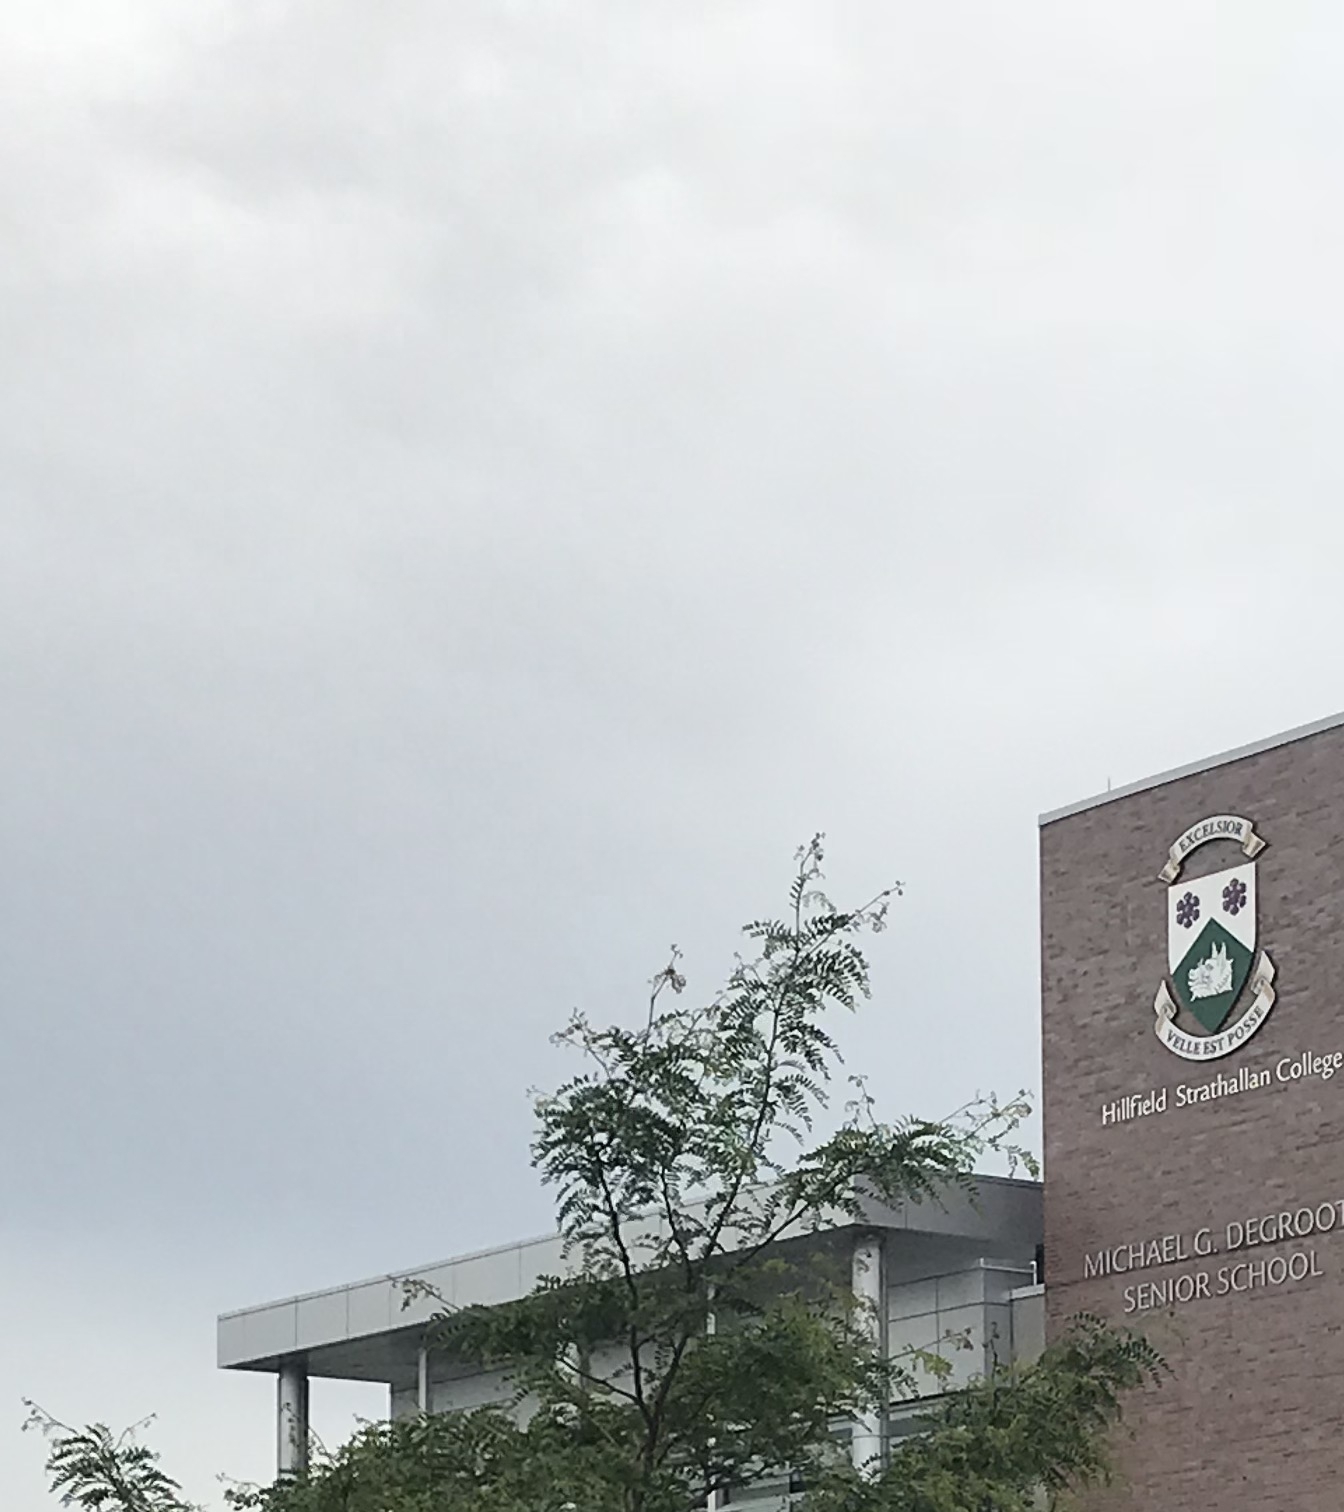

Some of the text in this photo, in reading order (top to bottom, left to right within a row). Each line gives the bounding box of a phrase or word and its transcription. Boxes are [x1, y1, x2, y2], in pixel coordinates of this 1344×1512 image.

[1178, 820, 1244, 853] EXCELSIOR
[1167, 1005, 1264, 1055] VELLE EST POSSE
[1102, 1051, 1343, 1125] Hillfield Strathallan College
[1084, 1234, 1188, 1279] MICHAEL
[1194, 1228, 1218, 1256] G.
[1123, 1250, 1324, 1313] SENIOR SCHOOL
